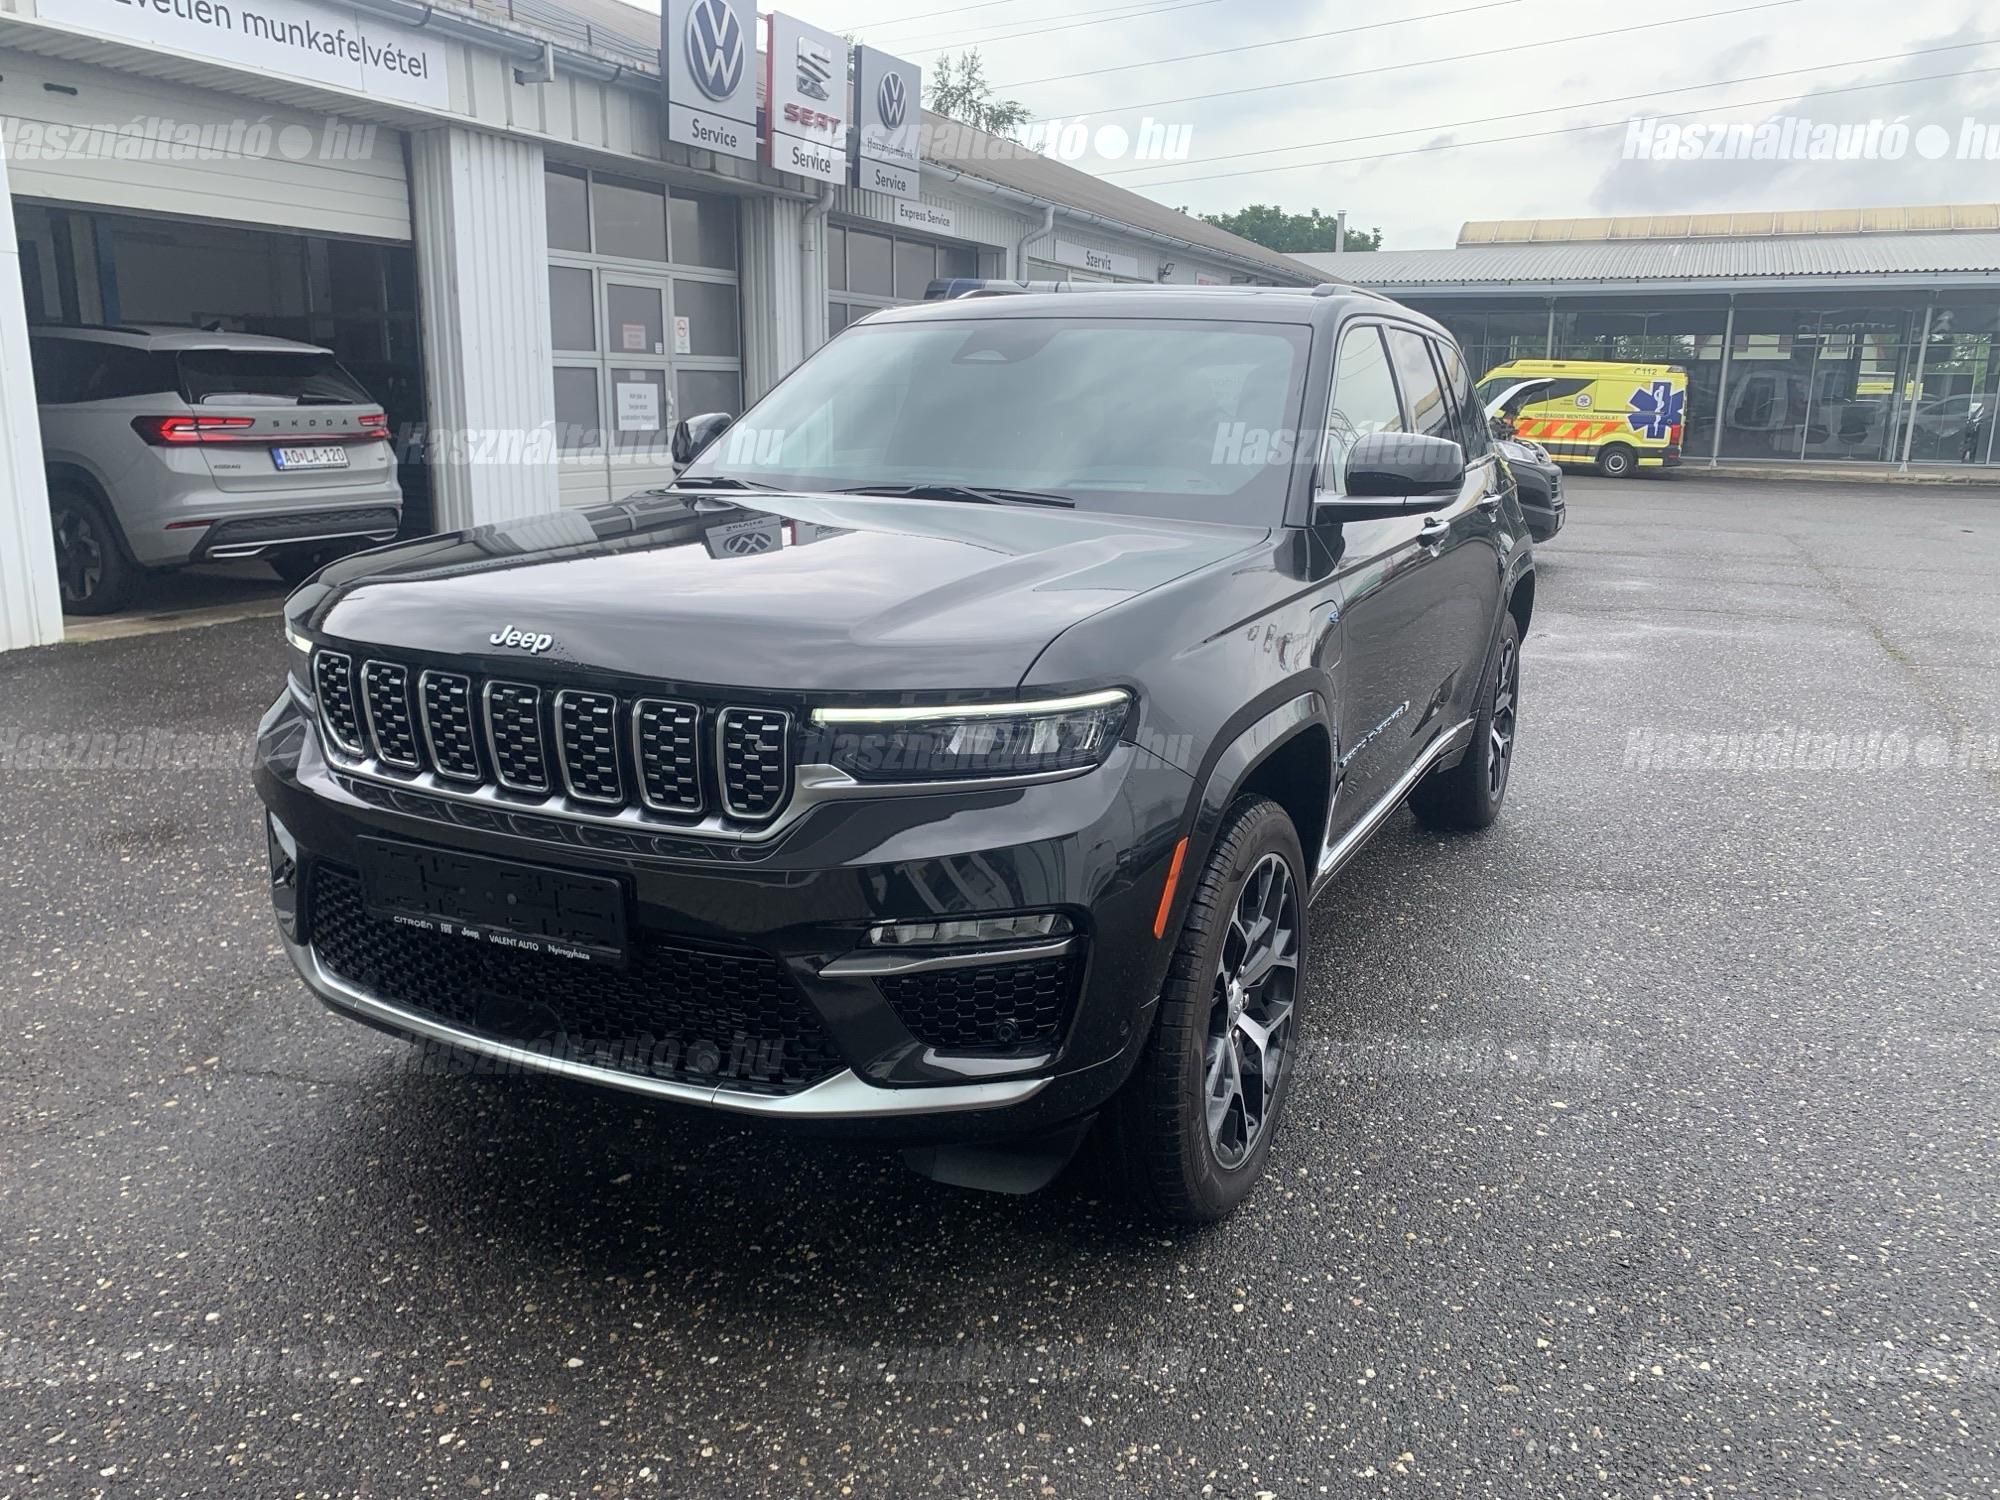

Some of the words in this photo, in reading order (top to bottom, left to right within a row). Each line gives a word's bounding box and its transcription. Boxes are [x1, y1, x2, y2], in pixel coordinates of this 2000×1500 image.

[241, 11, 428, 79] munkafelvétel
[784, 102, 841, 133] SEAT
[692, 118, 737, 148] Service
[792, 146, 831, 173] Service
[875, 169, 906, 192] Service
[900, 204, 926, 221] Express
[928, 210, 951, 227] Service
[1085, 250, 1112, 271] Szerviz
[489, 624, 554, 655] Jeep
[488, 933, 517, 948] VALENT
[518, 939, 539, 952] AUTO
